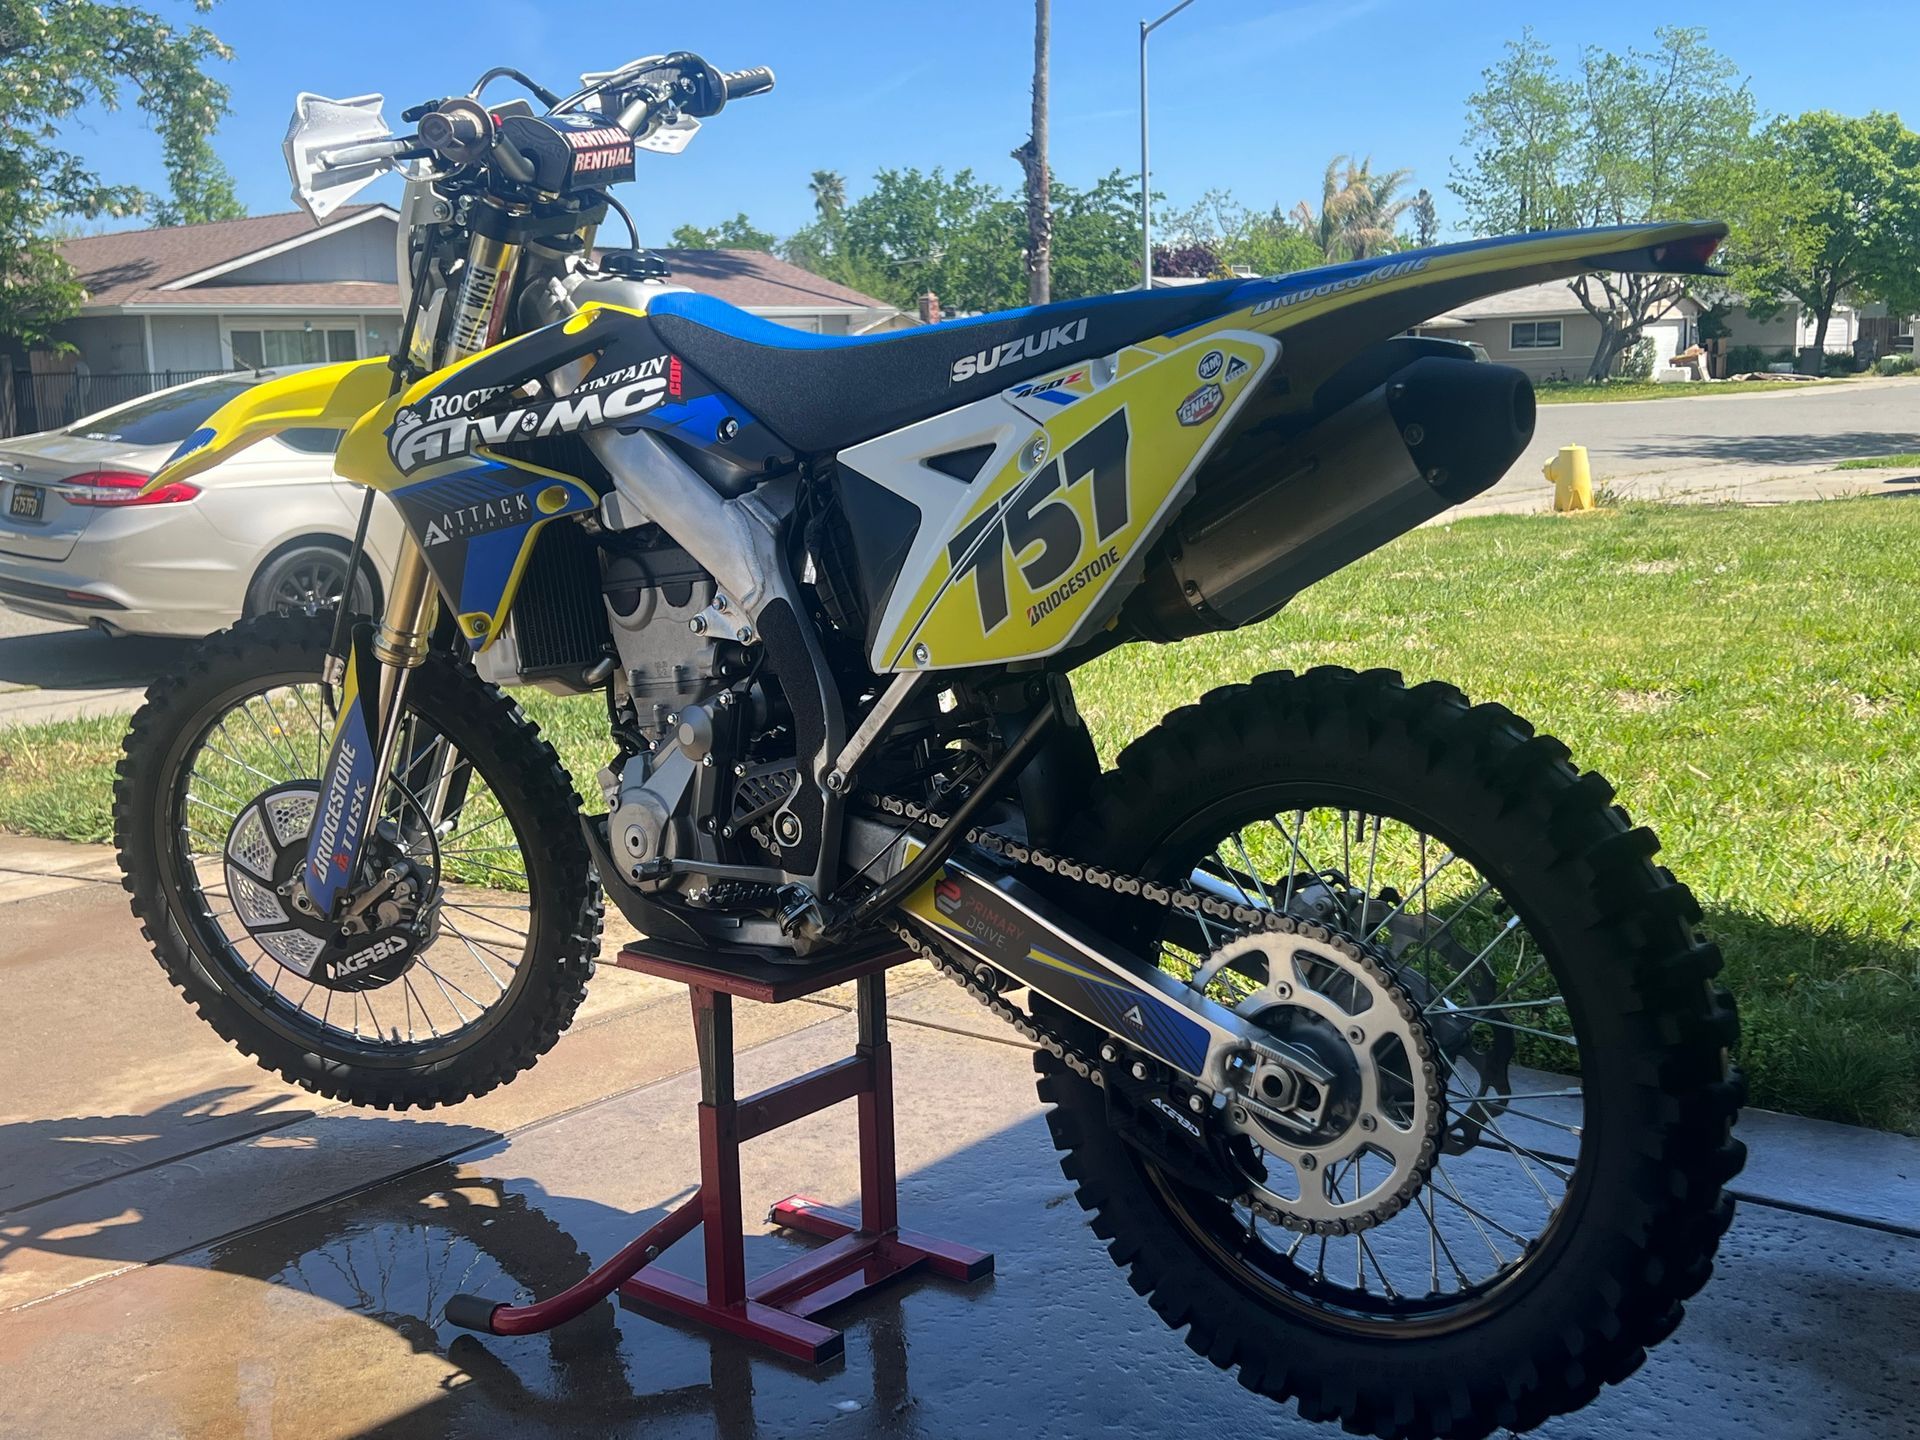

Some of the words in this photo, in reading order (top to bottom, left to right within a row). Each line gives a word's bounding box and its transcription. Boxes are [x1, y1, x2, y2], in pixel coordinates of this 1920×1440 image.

[565, 127, 631, 148] RENTHAL
[574, 147, 633, 172] RENTHAL
[952, 318, 1088, 382] SUZUKI
[1201, 354, 1222, 376] RM
[427, 384, 514, 422] ROCK
[1181, 389, 1220, 420] GNCC
[443, 494, 528, 530] ATTACK
[449, 513, 524, 538] GRAPHICS
[946, 405, 1131, 637] 757
[1027, 546, 1120, 628] BRIDGESTONE
[312, 739, 356, 885] BRIDGESTONE
[342, 779, 368, 851] TUSK
[966, 897, 1024, 940] PRIMARY
[337, 935, 408, 978] ACERBIS
